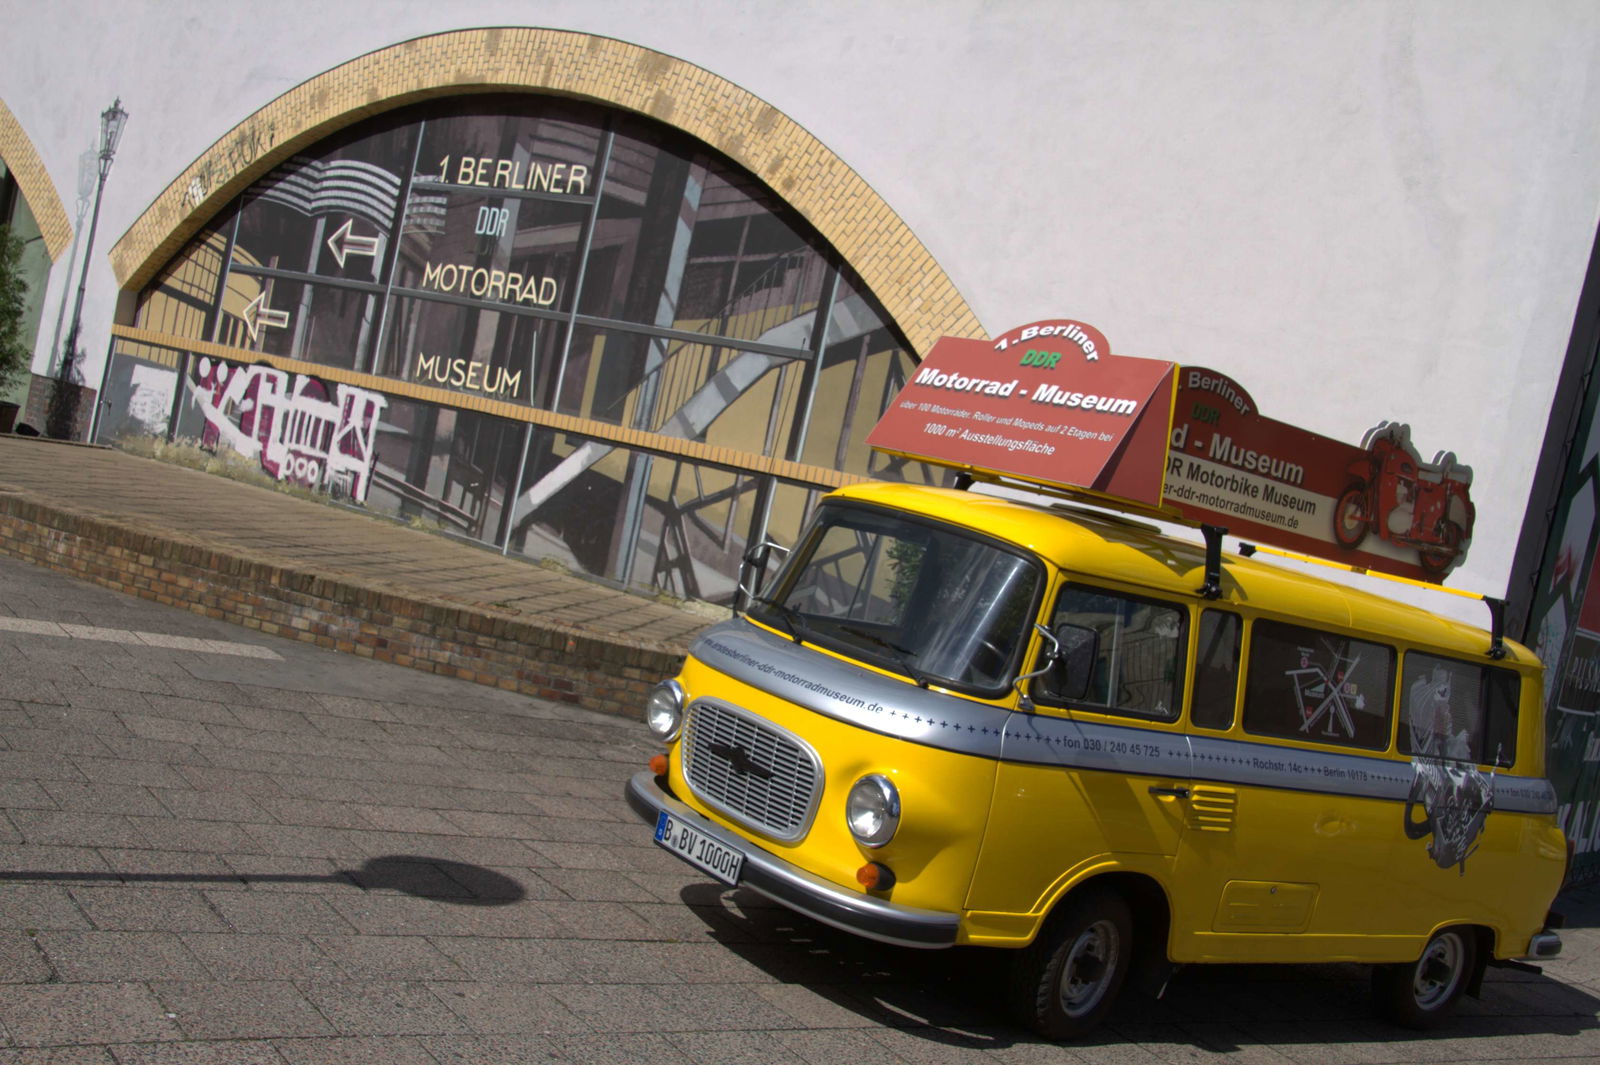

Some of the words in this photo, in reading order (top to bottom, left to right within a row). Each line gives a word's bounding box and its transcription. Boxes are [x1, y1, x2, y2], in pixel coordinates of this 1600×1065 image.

[438, 155, 450, 184] 1.
[457, 156, 588, 194] BERLINER
[475, 206, 510, 237] DDR
[422, 261, 557, 306] MOTORRAD
[1020, 349, 1062, 369] DDR
[1021, 324, 1099, 361] Berliner
[416, 352, 522, 398] MUSEUM
[915, 367, 1019, 398] Motorrad
[1032, 383, 1138, 415] Museum
[1188, 371, 1251, 415] Berliner
[1012, 418, 1045, 431] Mopeds
[1045, 424, 1061, 433] auf
[1060, 425, 1068, 435] 2
[1067, 426, 1098, 440] Etagen
[1098, 432, 1116, 442] bei
[1191, 402, 1221, 426] DDR
[923, 422, 947, 436] 1000
[959, 429, 1056, 456] Ausstellungsfläche
[1209, 433, 1304, 485] Museum
[1186, 462, 1259, 498] Motorbike
[1262, 484, 1317, 516] Museum
[1063, 736, 1080, 749] fon
[1083, 738, 1102, 752] 030
[1110, 741, 1127, 754] 240
[1129, 744, 1141, 756] 45
[1143, 745, 1160, 758] 725
[1253, 758, 1287, 773] Rochstr.
[1323, 766, 1346, 779] Berlin
[663, 819, 674, 842] B
[679, 828, 698, 855] BV
[696, 839, 741, 881] 1000H
